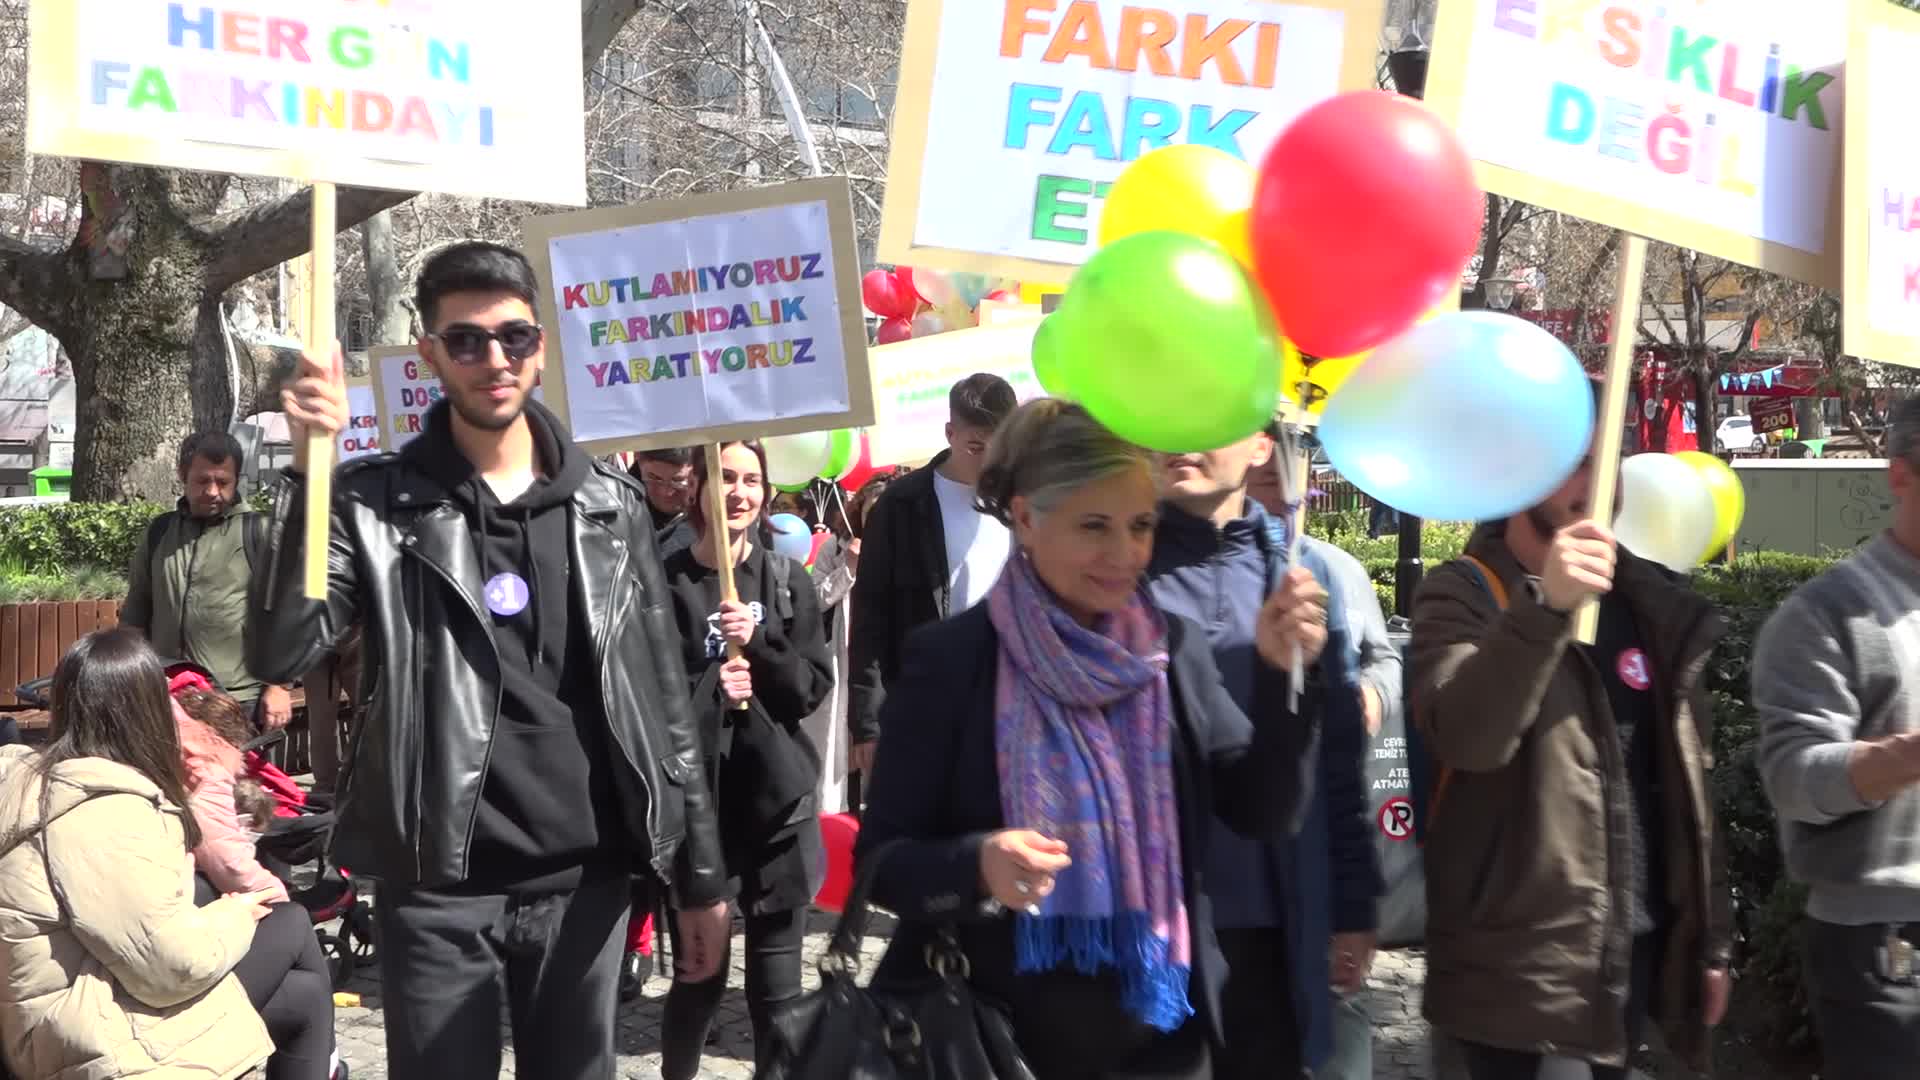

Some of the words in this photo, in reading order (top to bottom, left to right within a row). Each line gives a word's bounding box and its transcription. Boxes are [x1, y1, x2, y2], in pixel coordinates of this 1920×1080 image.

[167, 3, 311, 63] HER
[328, 24, 471, 83] GN
[999, 0, 1282, 89] FARKI
[1003, 82, 1261, 162] FARK
[1544, 80, 1757, 197] DEĞİL
[1031, 173, 1112, 245] E
[563, 253, 825, 310] KUTLAMIYORUZ
[589, 295, 808, 347] FARKINDALIK
[585, 337, 817, 388] YARATIYORUZ
[394, 413, 429, 433] KR
[1761, 413, 1789, 429] 200
